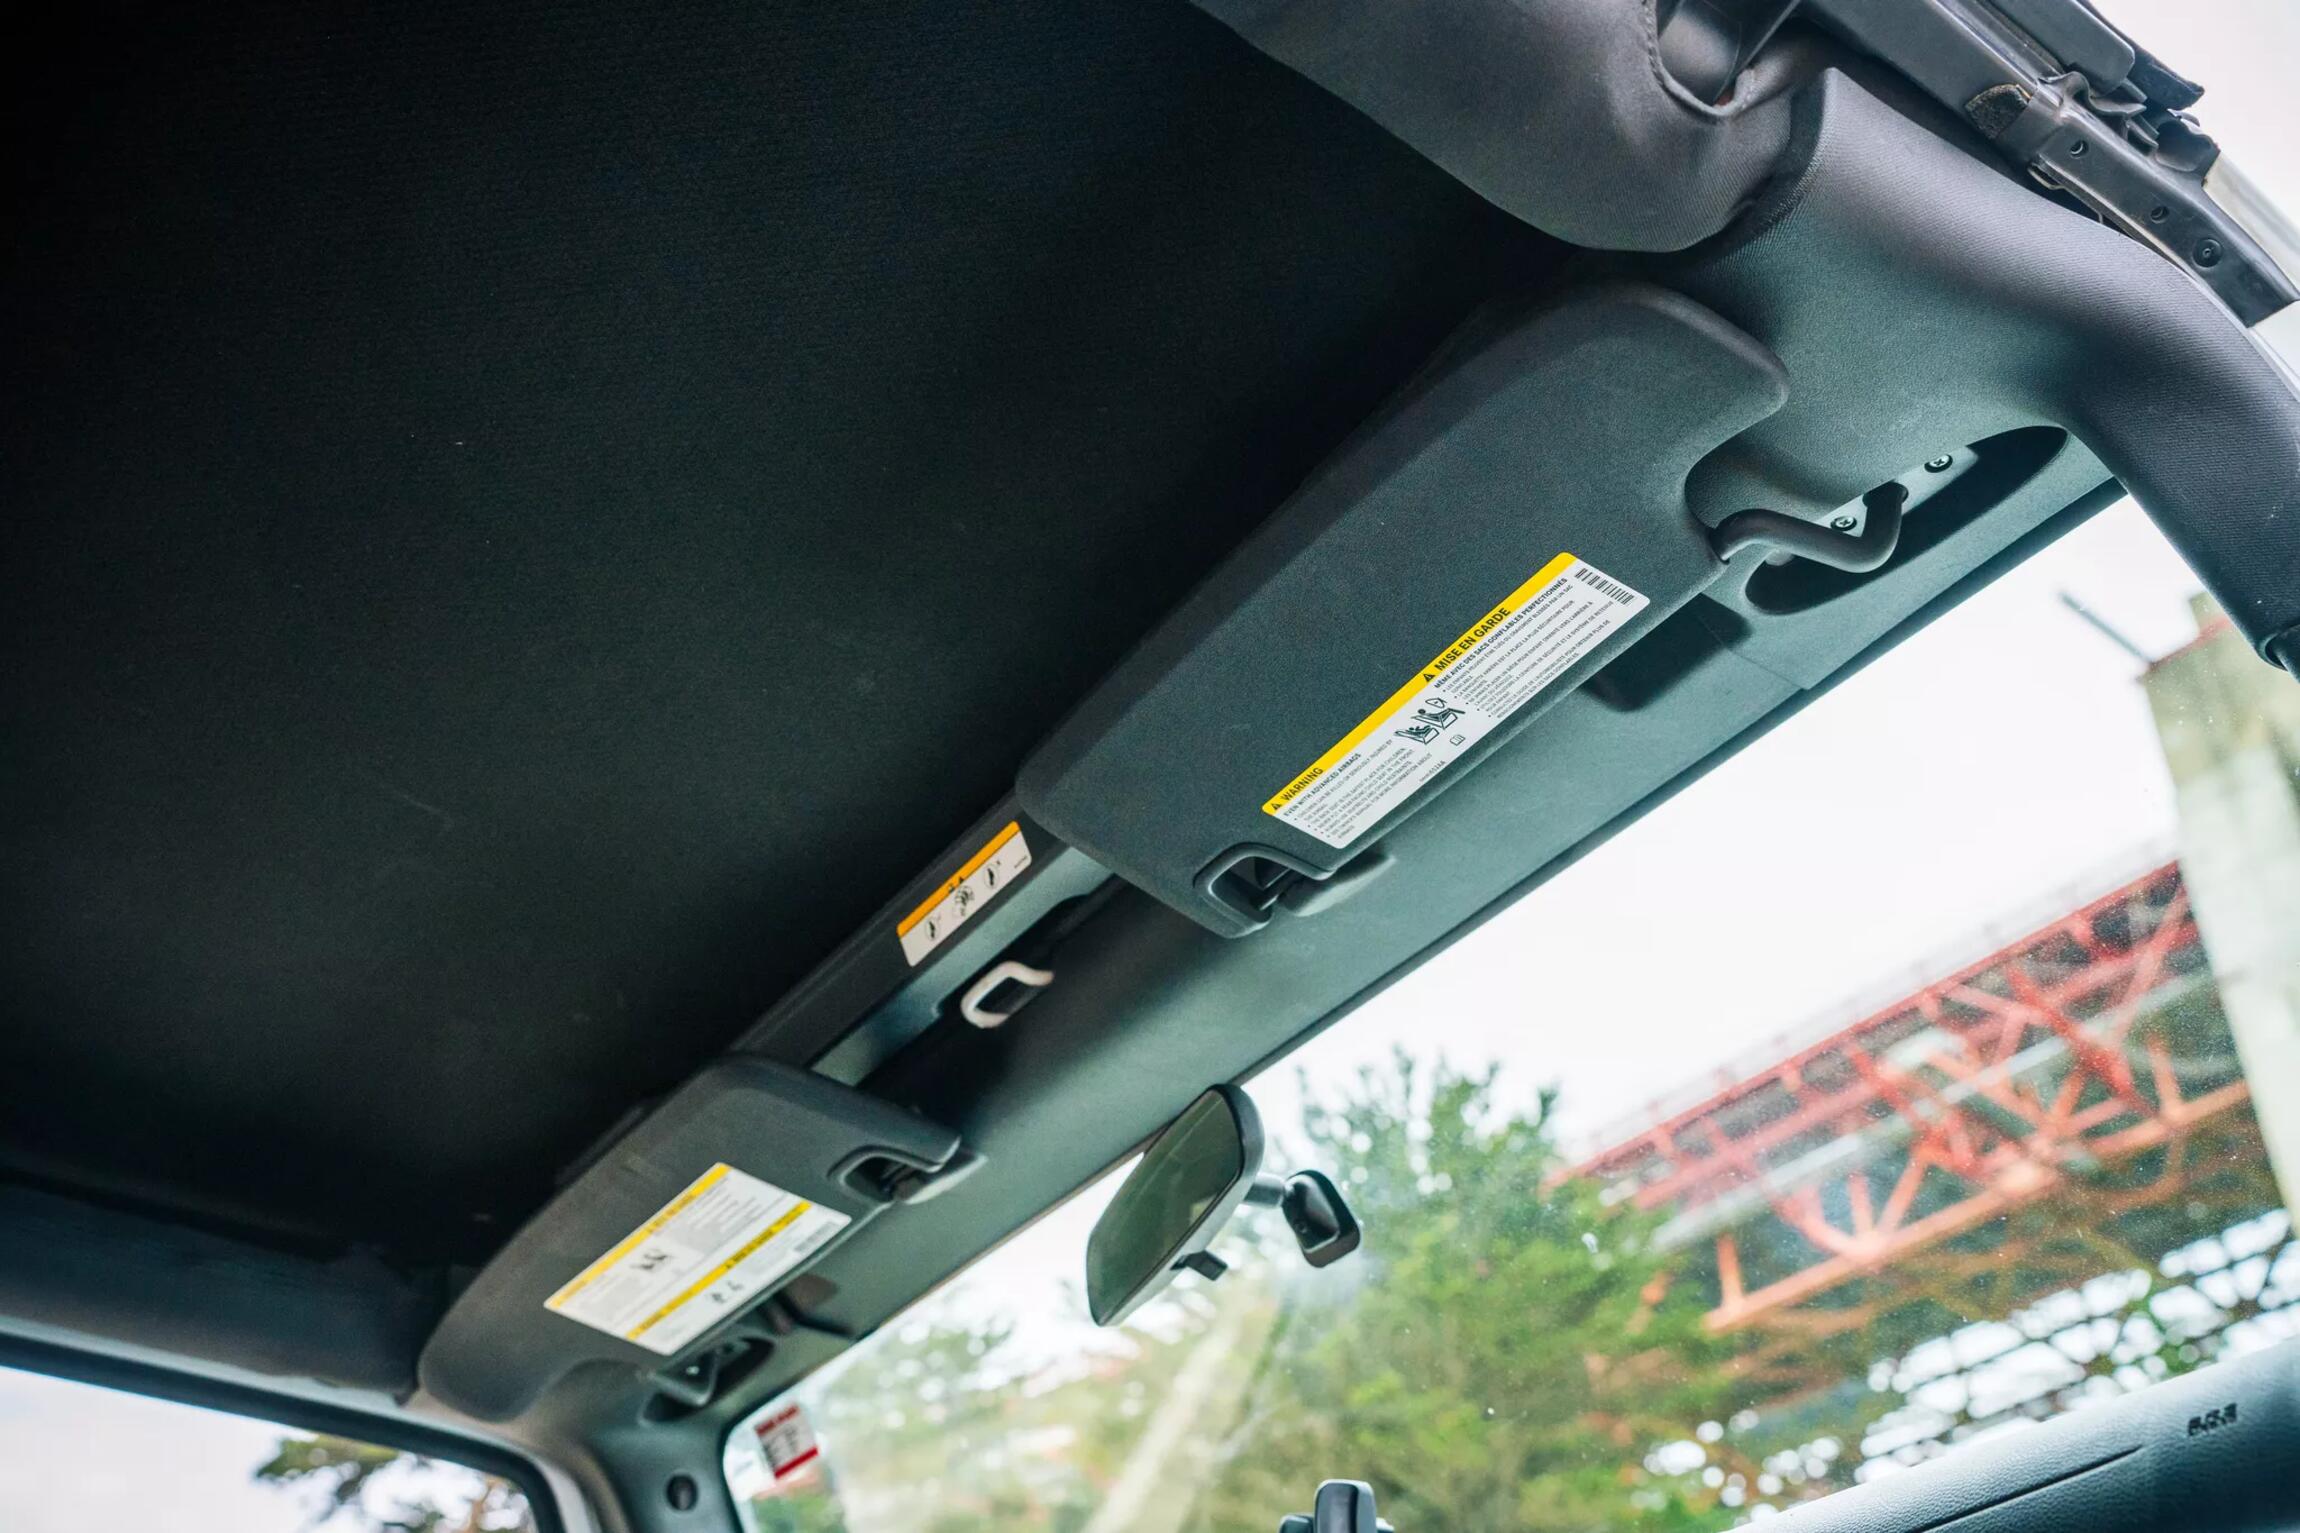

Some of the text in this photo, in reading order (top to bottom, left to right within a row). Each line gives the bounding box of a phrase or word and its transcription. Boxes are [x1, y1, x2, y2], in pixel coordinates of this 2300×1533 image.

[1433, 607, 1511, 670] MISE EN GARDE
[1448, 662, 1465, 675] AVEC
[1462, 653, 1476, 664] DES
[1473, 642, 1490, 655] SACS
[1486, 614, 1524, 644] GONFLABLES
[1520, 577, 1568, 615] PERFECTIONNÉS
[1279, 766, 1324, 801] WARNING
[1282, 804, 1299, 816] EVEN
[1296, 793, 1313, 805] WITH
[1309, 771, 1339, 794] ADVANCED
[1336, 752, 1362, 772] AIRBAGS
